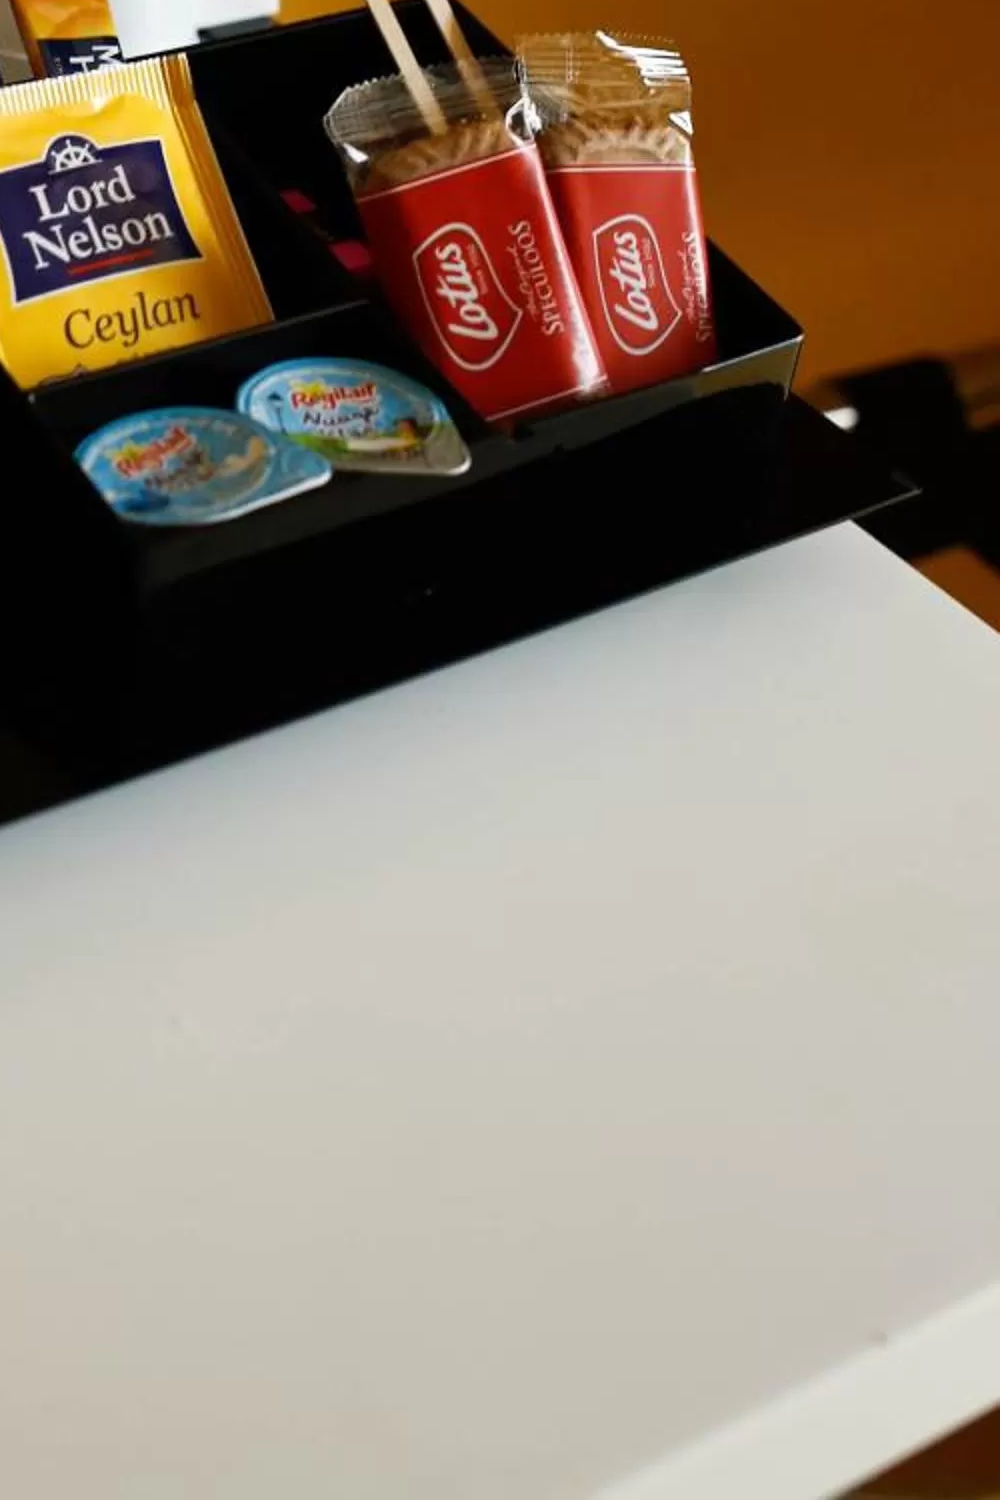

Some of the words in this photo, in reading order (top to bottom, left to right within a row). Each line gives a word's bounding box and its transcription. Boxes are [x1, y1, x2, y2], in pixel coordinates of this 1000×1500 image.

[28, 164, 136, 222] Lord
[22, 211, 175, 270] Nelson
[434, 243, 499, 340] Lotus
[609, 231, 659, 331] Lotus
[64, 291, 201, 349] Ceylan
